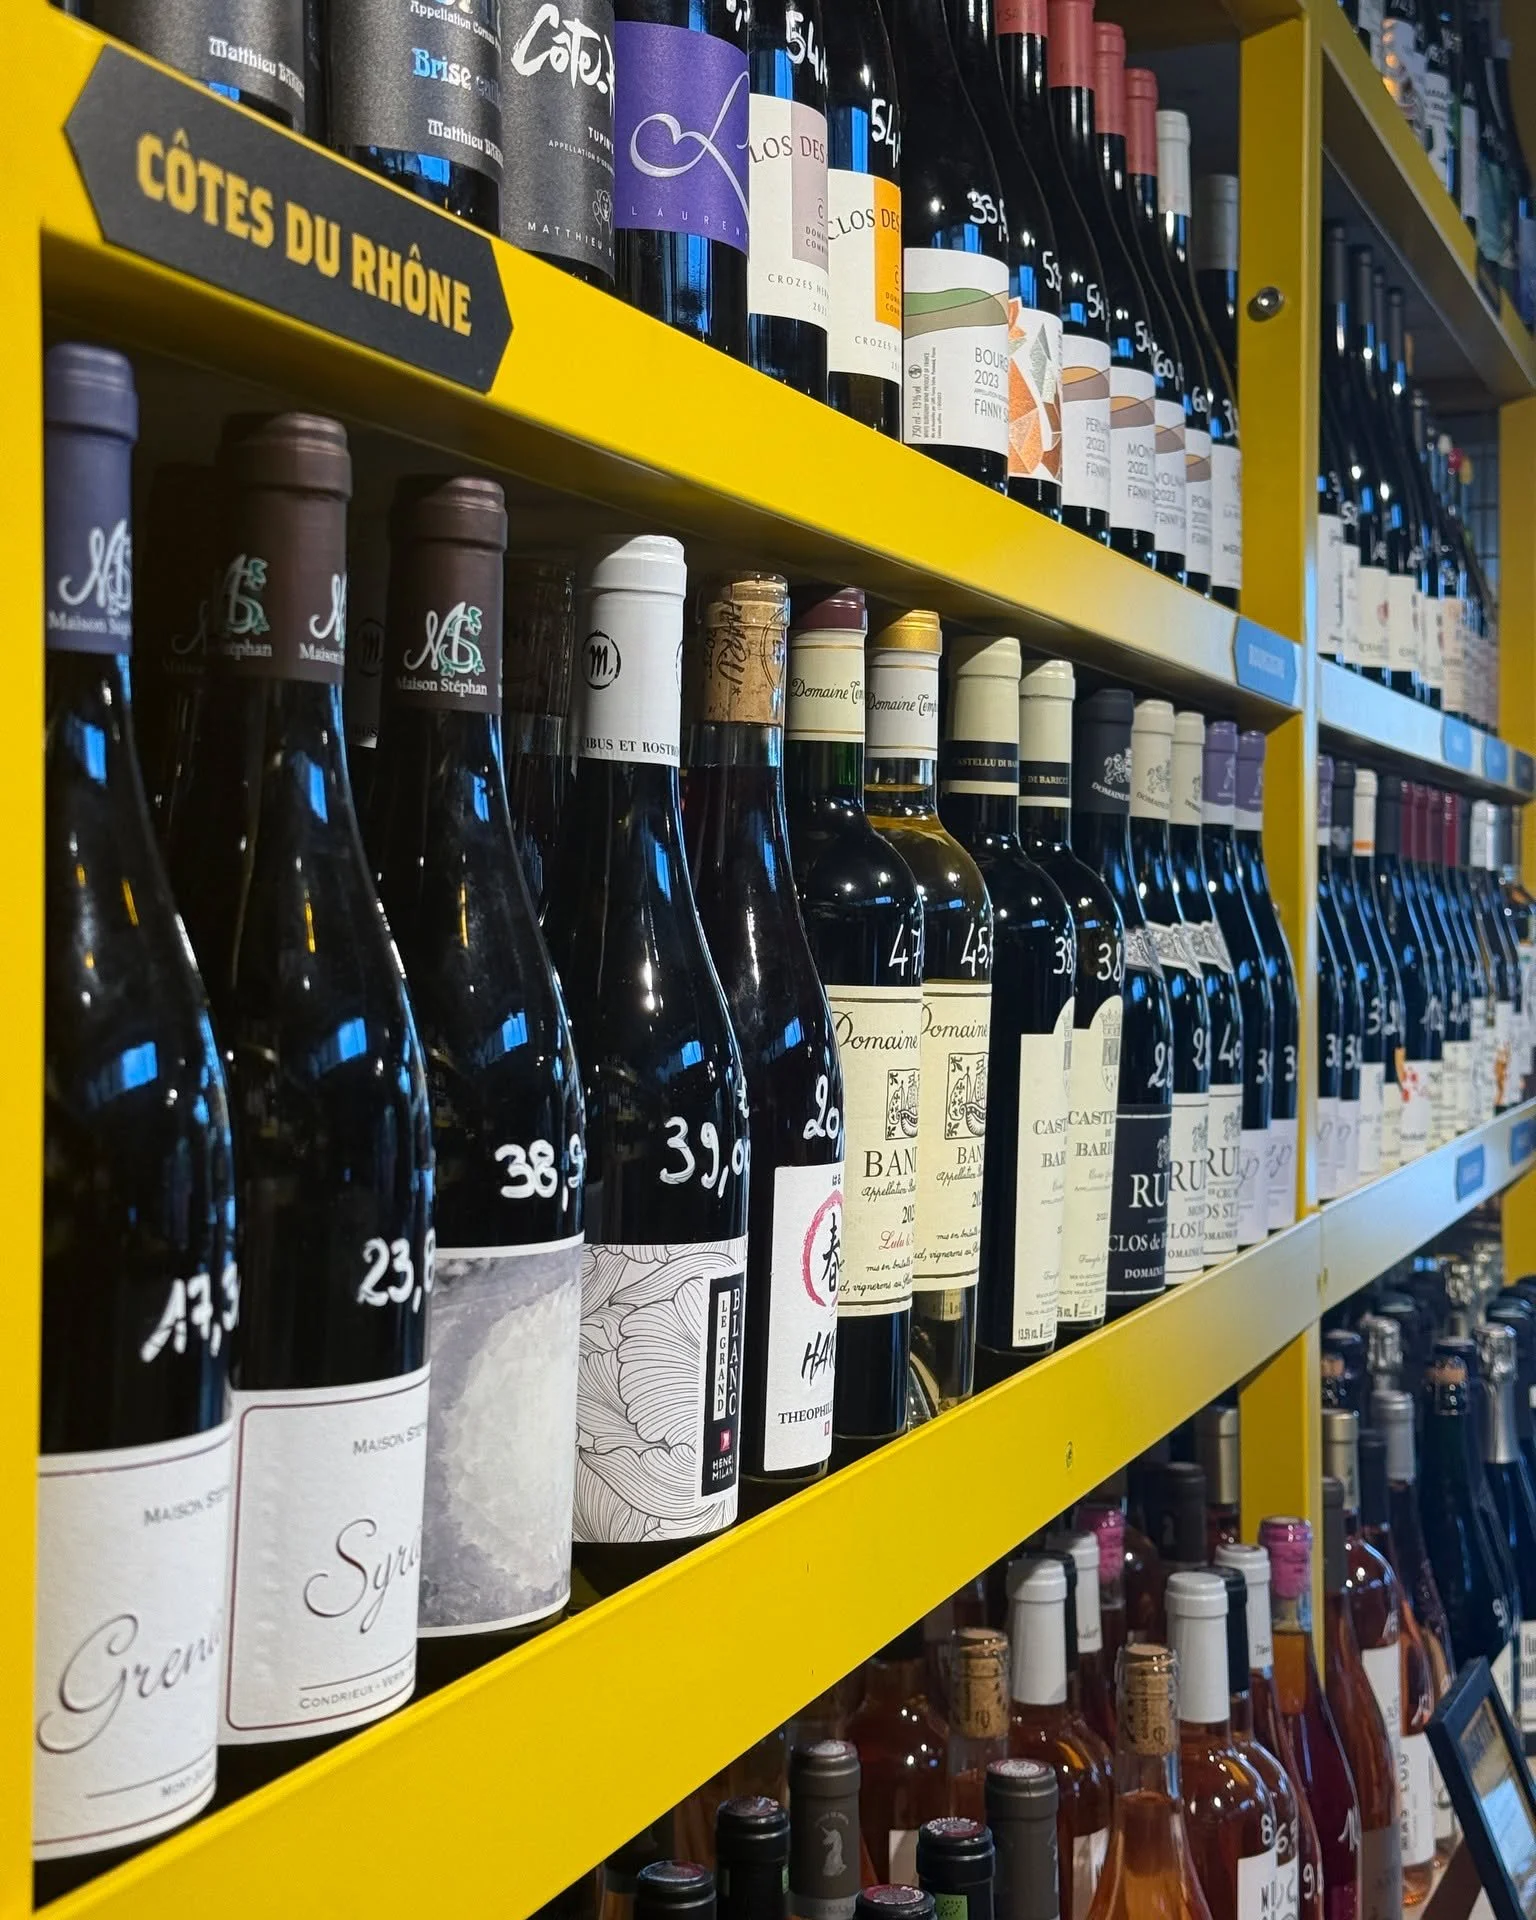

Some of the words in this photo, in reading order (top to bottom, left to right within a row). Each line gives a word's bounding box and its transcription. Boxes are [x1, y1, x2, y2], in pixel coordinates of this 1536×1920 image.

[208, 35, 278, 77] Matthieu
[785, 10, 829, 89] 54,
[411, 47, 473, 91] Brise
[427, 118, 484, 151] Matthieu
[871, 98, 902, 169] 54,
[548, 139, 596, 161] APPELLATION
[800, 135, 826, 165] DES
[136, 127, 275, 259] CÔTES
[286, 201, 340, 280] DU
[350, 243, 472, 337] RHÔNE
[527, 221, 603, 251] MATTHIEU
[631, 205, 748, 243] LAUREN
[828, 208, 876, 241] CLOS
[881, 208, 900, 233] DES
[767, 273, 813, 291] CROZES
[854, 335, 892, 351] CROZES
[975, 369, 1000, 389] 2023
[974, 398, 1001, 420] FANNY
[912, 425, 922, 438] 750
[440, 677, 489, 698] Stéphan
[790, 677, 849, 701] Domaine
[867, 691, 915, 712] Domaine
[619, 739, 637, 752] ET
[832, 1011, 918, 1050] Domaine
[921, 1002, 988, 1038] Domaine
[1108, 1235, 1149, 1254] CLOS
[720, 1300, 729, 1329] LE
[728, 1288, 741, 1417] BLANC
[717, 1336, 727, 1412] GRAND
[712, 1454, 734, 1470] HENRI
[712, 1467, 734, 1482] MILAN
